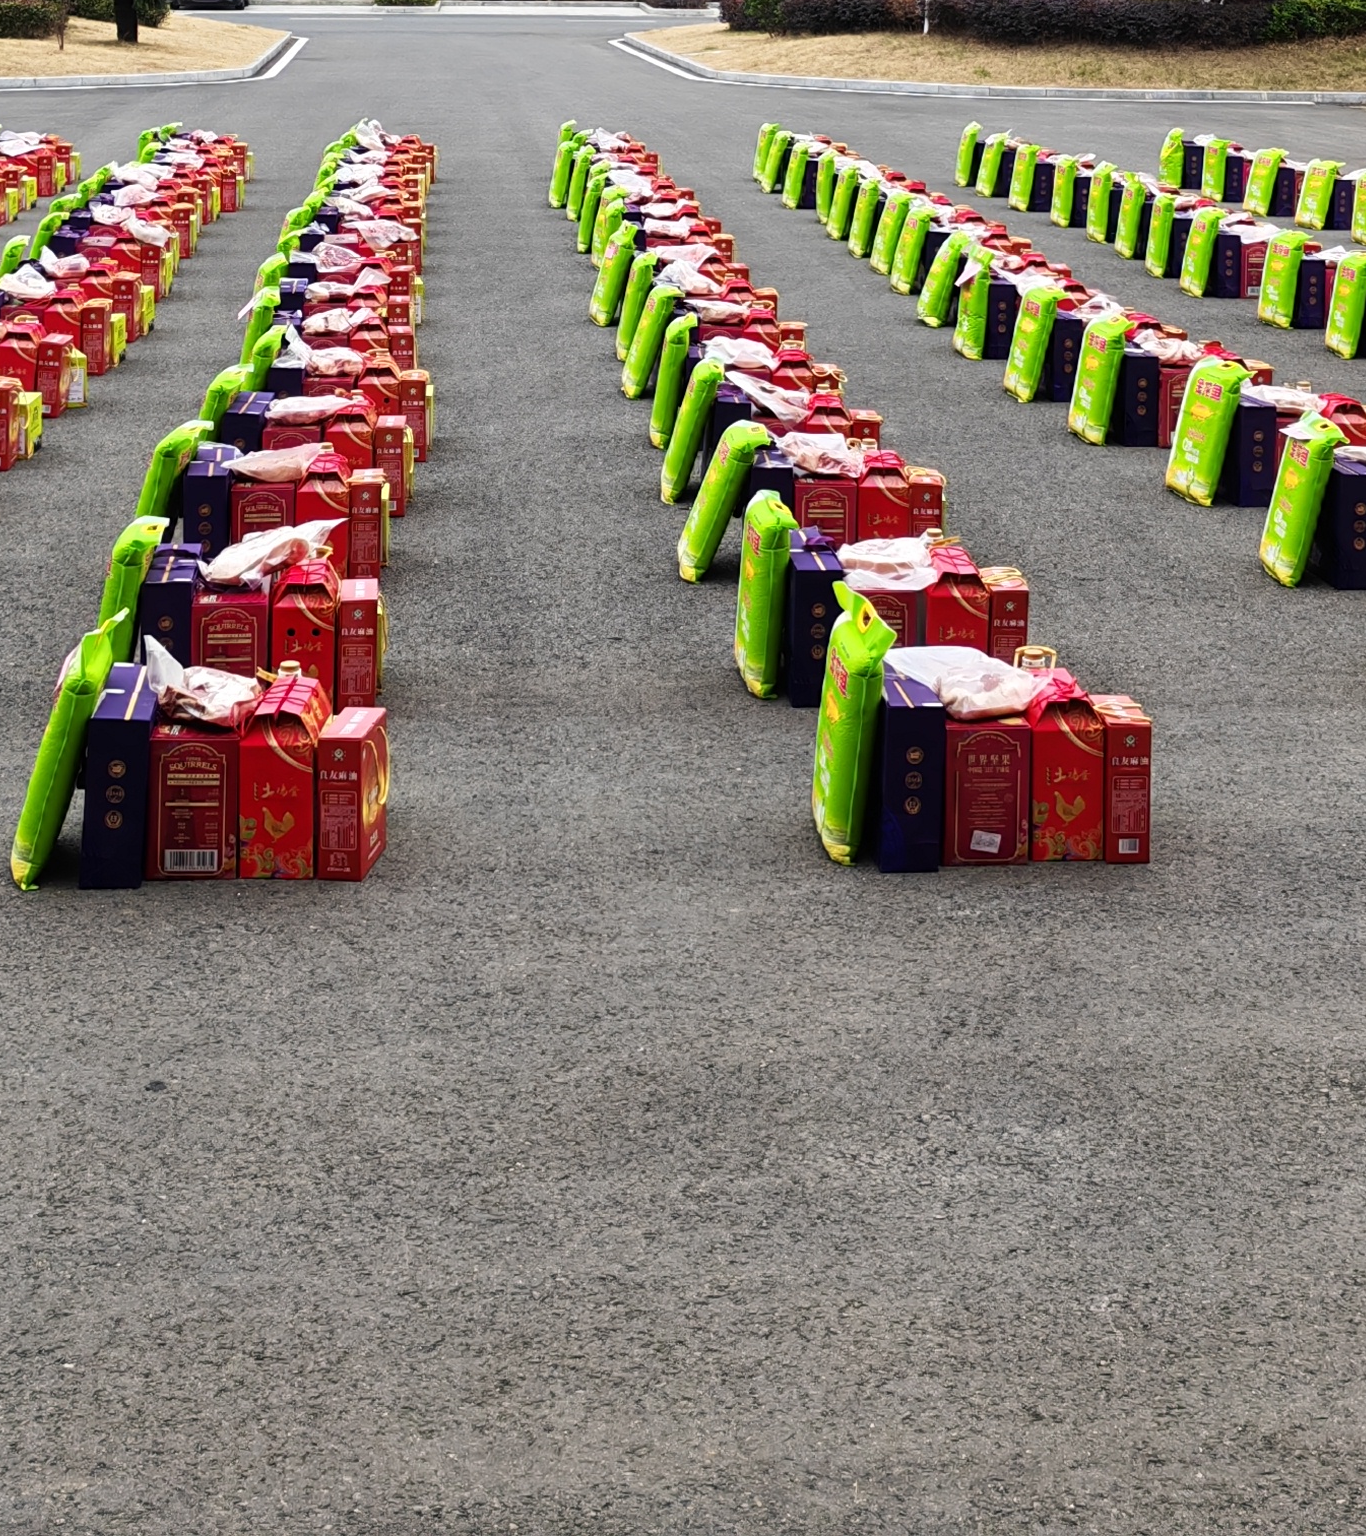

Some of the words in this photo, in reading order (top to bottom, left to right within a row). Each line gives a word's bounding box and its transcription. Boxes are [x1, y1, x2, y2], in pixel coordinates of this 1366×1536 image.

[1195, 377, 1223, 402] 金龙鱼
[351, 506, 380, 514] 良友麻油
[208, 622, 250, 633] SQUIRRELS
[993, 618, 1025, 628] 良友麻油
[341, 627, 374, 637] 良友麻油
[968, 754, 1010, 765] 世界坚果
[1111, 756, 1150, 766] 良友麻油
[169, 762, 218, 772] SQUIRRELS
[319, 769, 358, 781] 良友麻油
